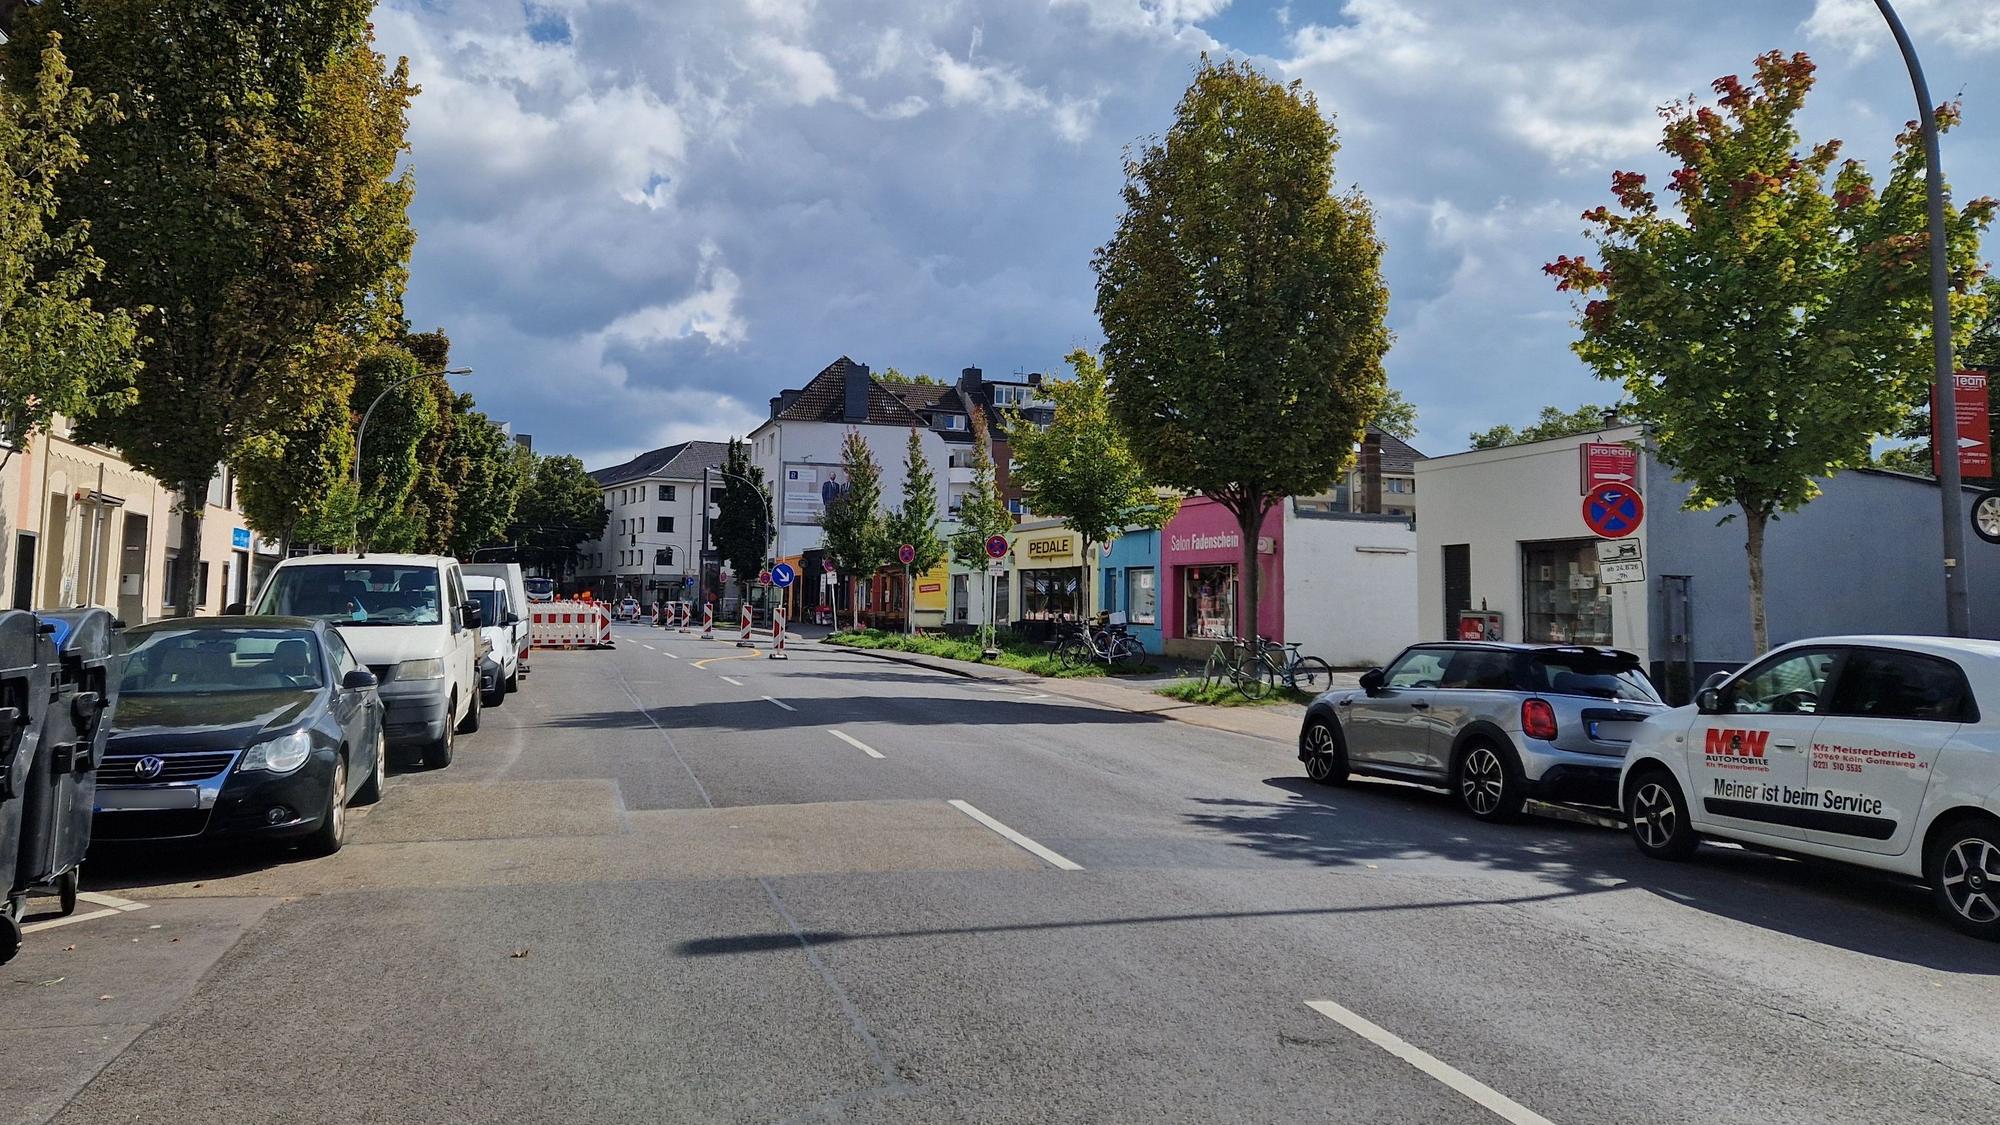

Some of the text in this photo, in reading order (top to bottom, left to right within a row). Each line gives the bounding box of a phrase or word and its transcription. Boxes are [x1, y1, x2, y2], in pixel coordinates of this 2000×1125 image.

[1029, 539, 1069, 555] PEDALE
[1171, 530, 1239, 551] Salon Fadenschein
[1705, 728, 1770, 758] M&W
[1813, 743, 1916, 760] Kfz Meisterbetrieb
[1706, 755, 1769, 766] AUTOMOBILE
[1813, 760, 1829, 769] 0221
[1866, 756, 1916, 769] Gottesweg
[1919, 761, 1929, 769] 41
[1714, 778, 1882, 815] Meiner ist beim Service
